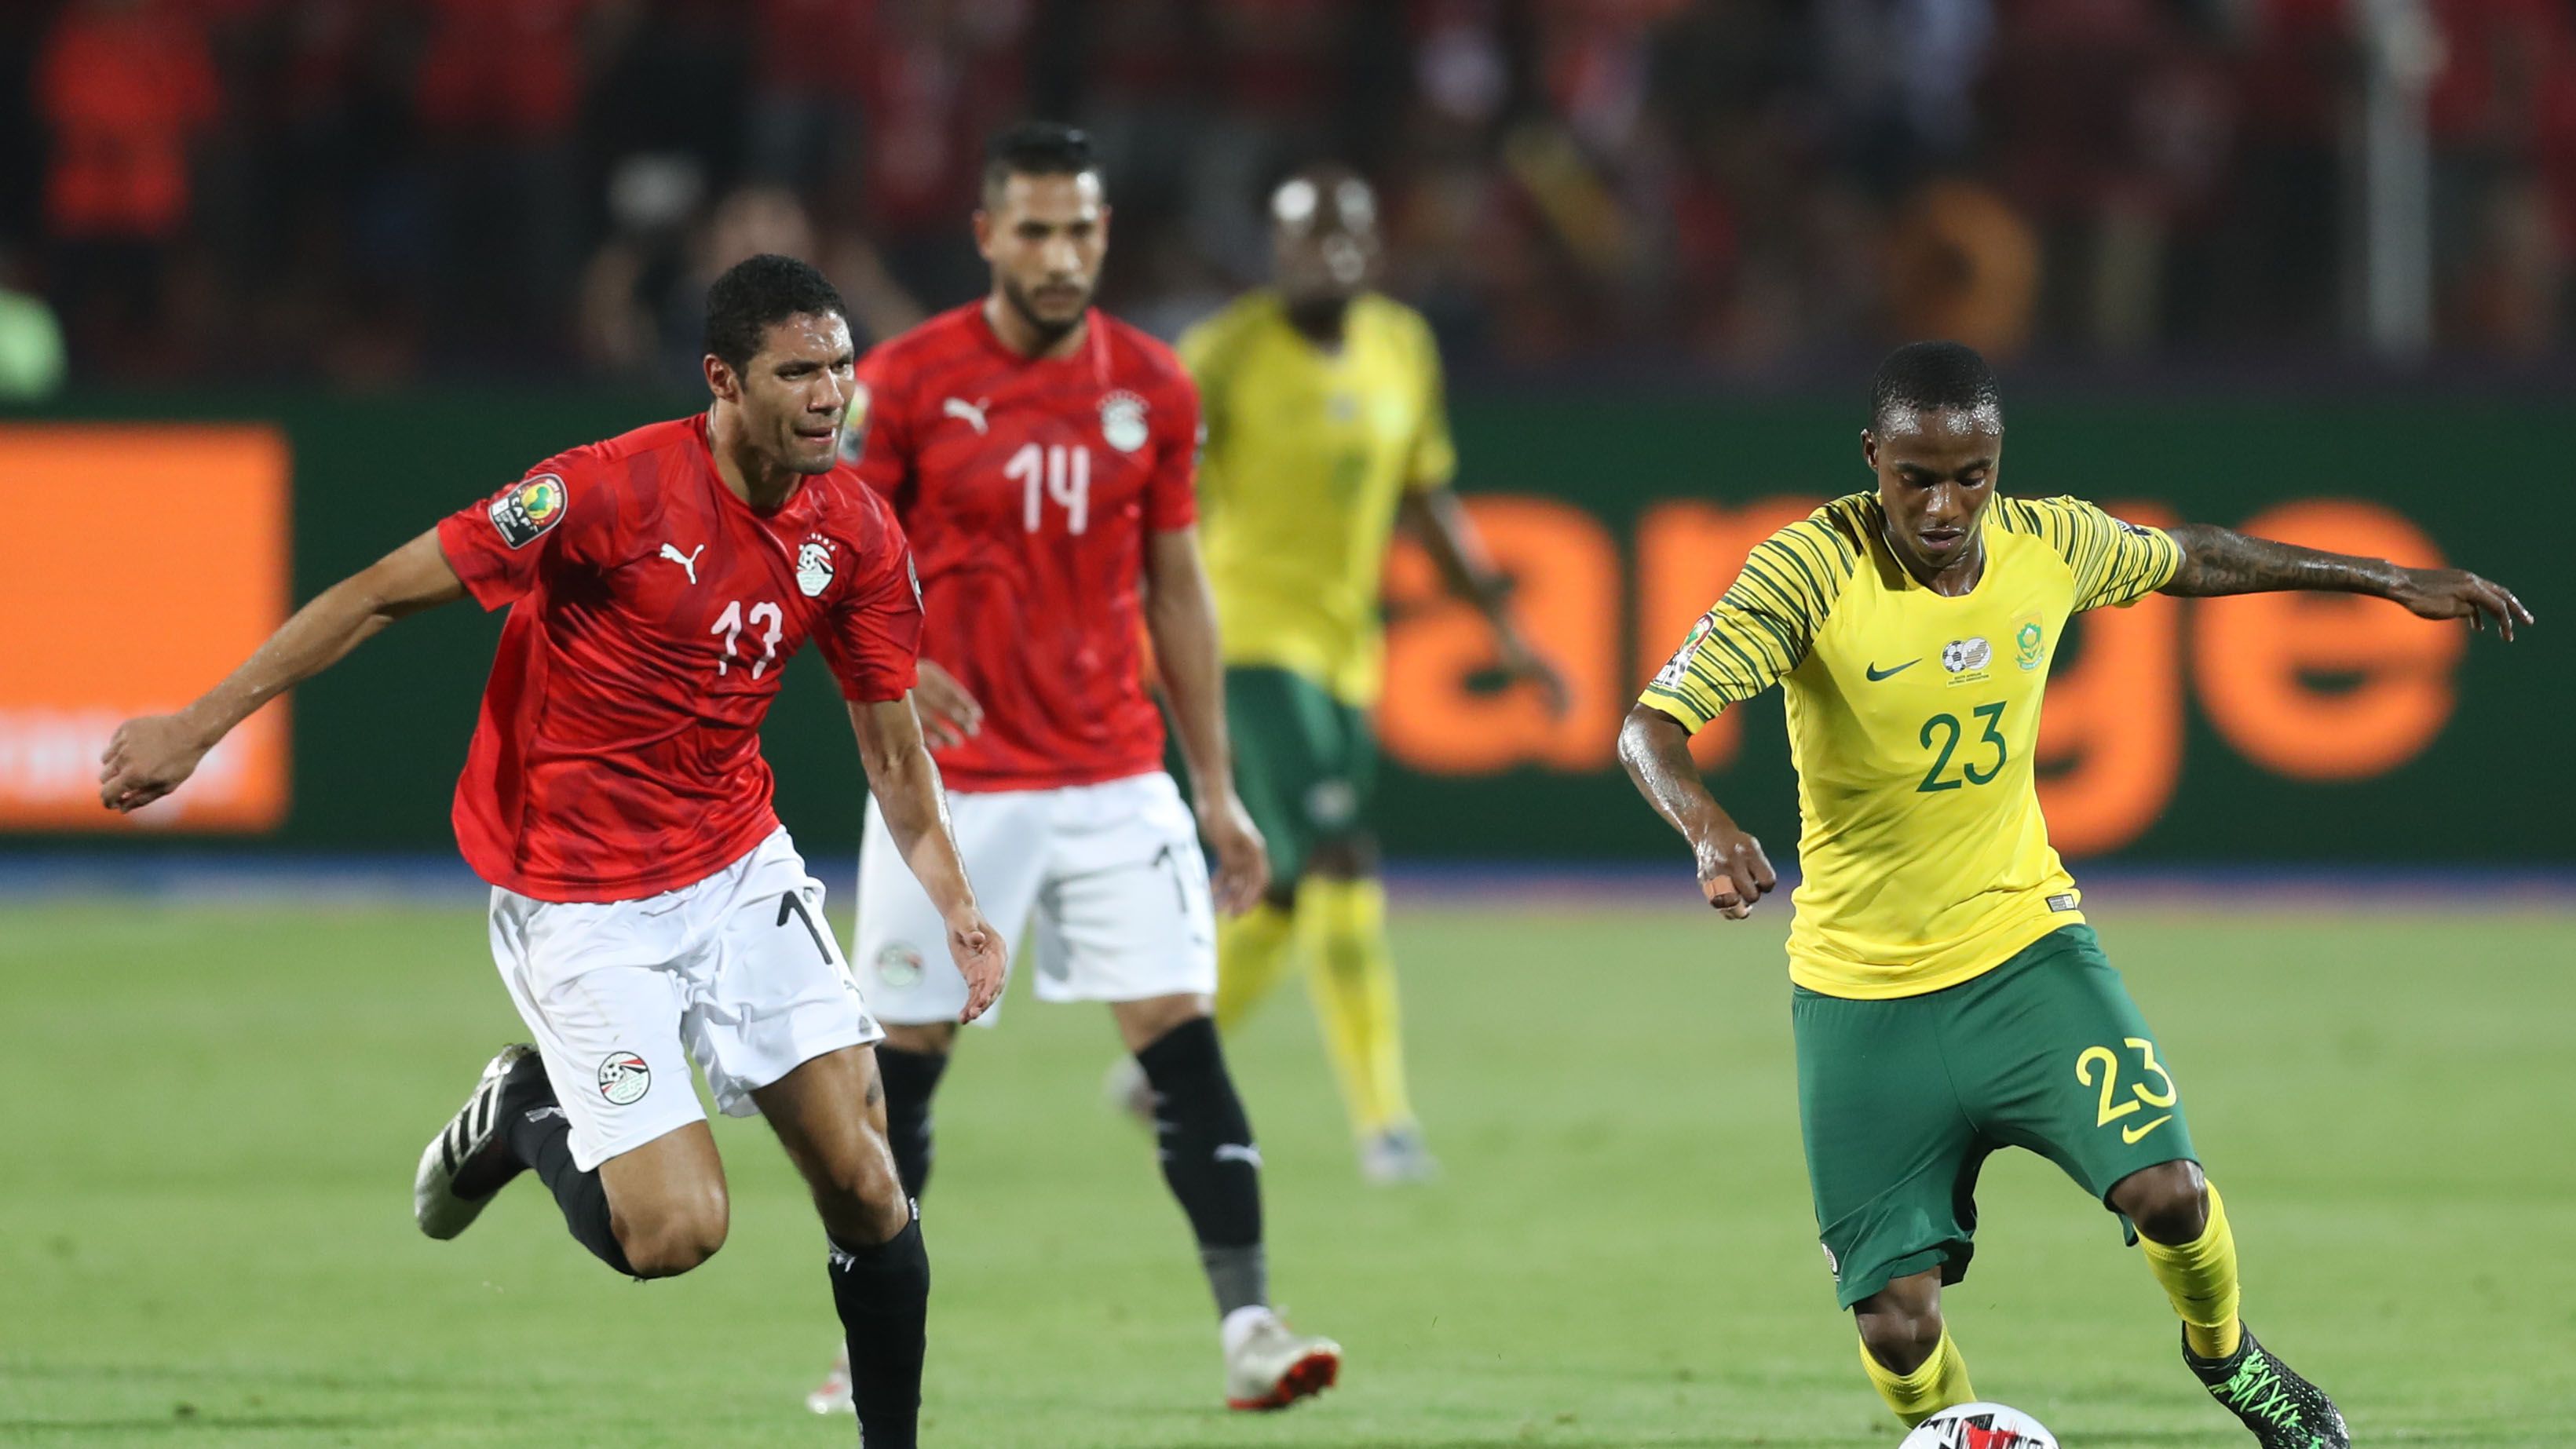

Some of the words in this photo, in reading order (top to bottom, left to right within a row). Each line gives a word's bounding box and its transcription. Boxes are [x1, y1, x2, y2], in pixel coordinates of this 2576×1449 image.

[1003, 443, 1090, 535] 14
[711, 600, 782, 681] 17
[1916, 700, 2008, 792] 23
[776, 888, 832, 965] 1
[2076, 1037, 2176, 1128] 23
